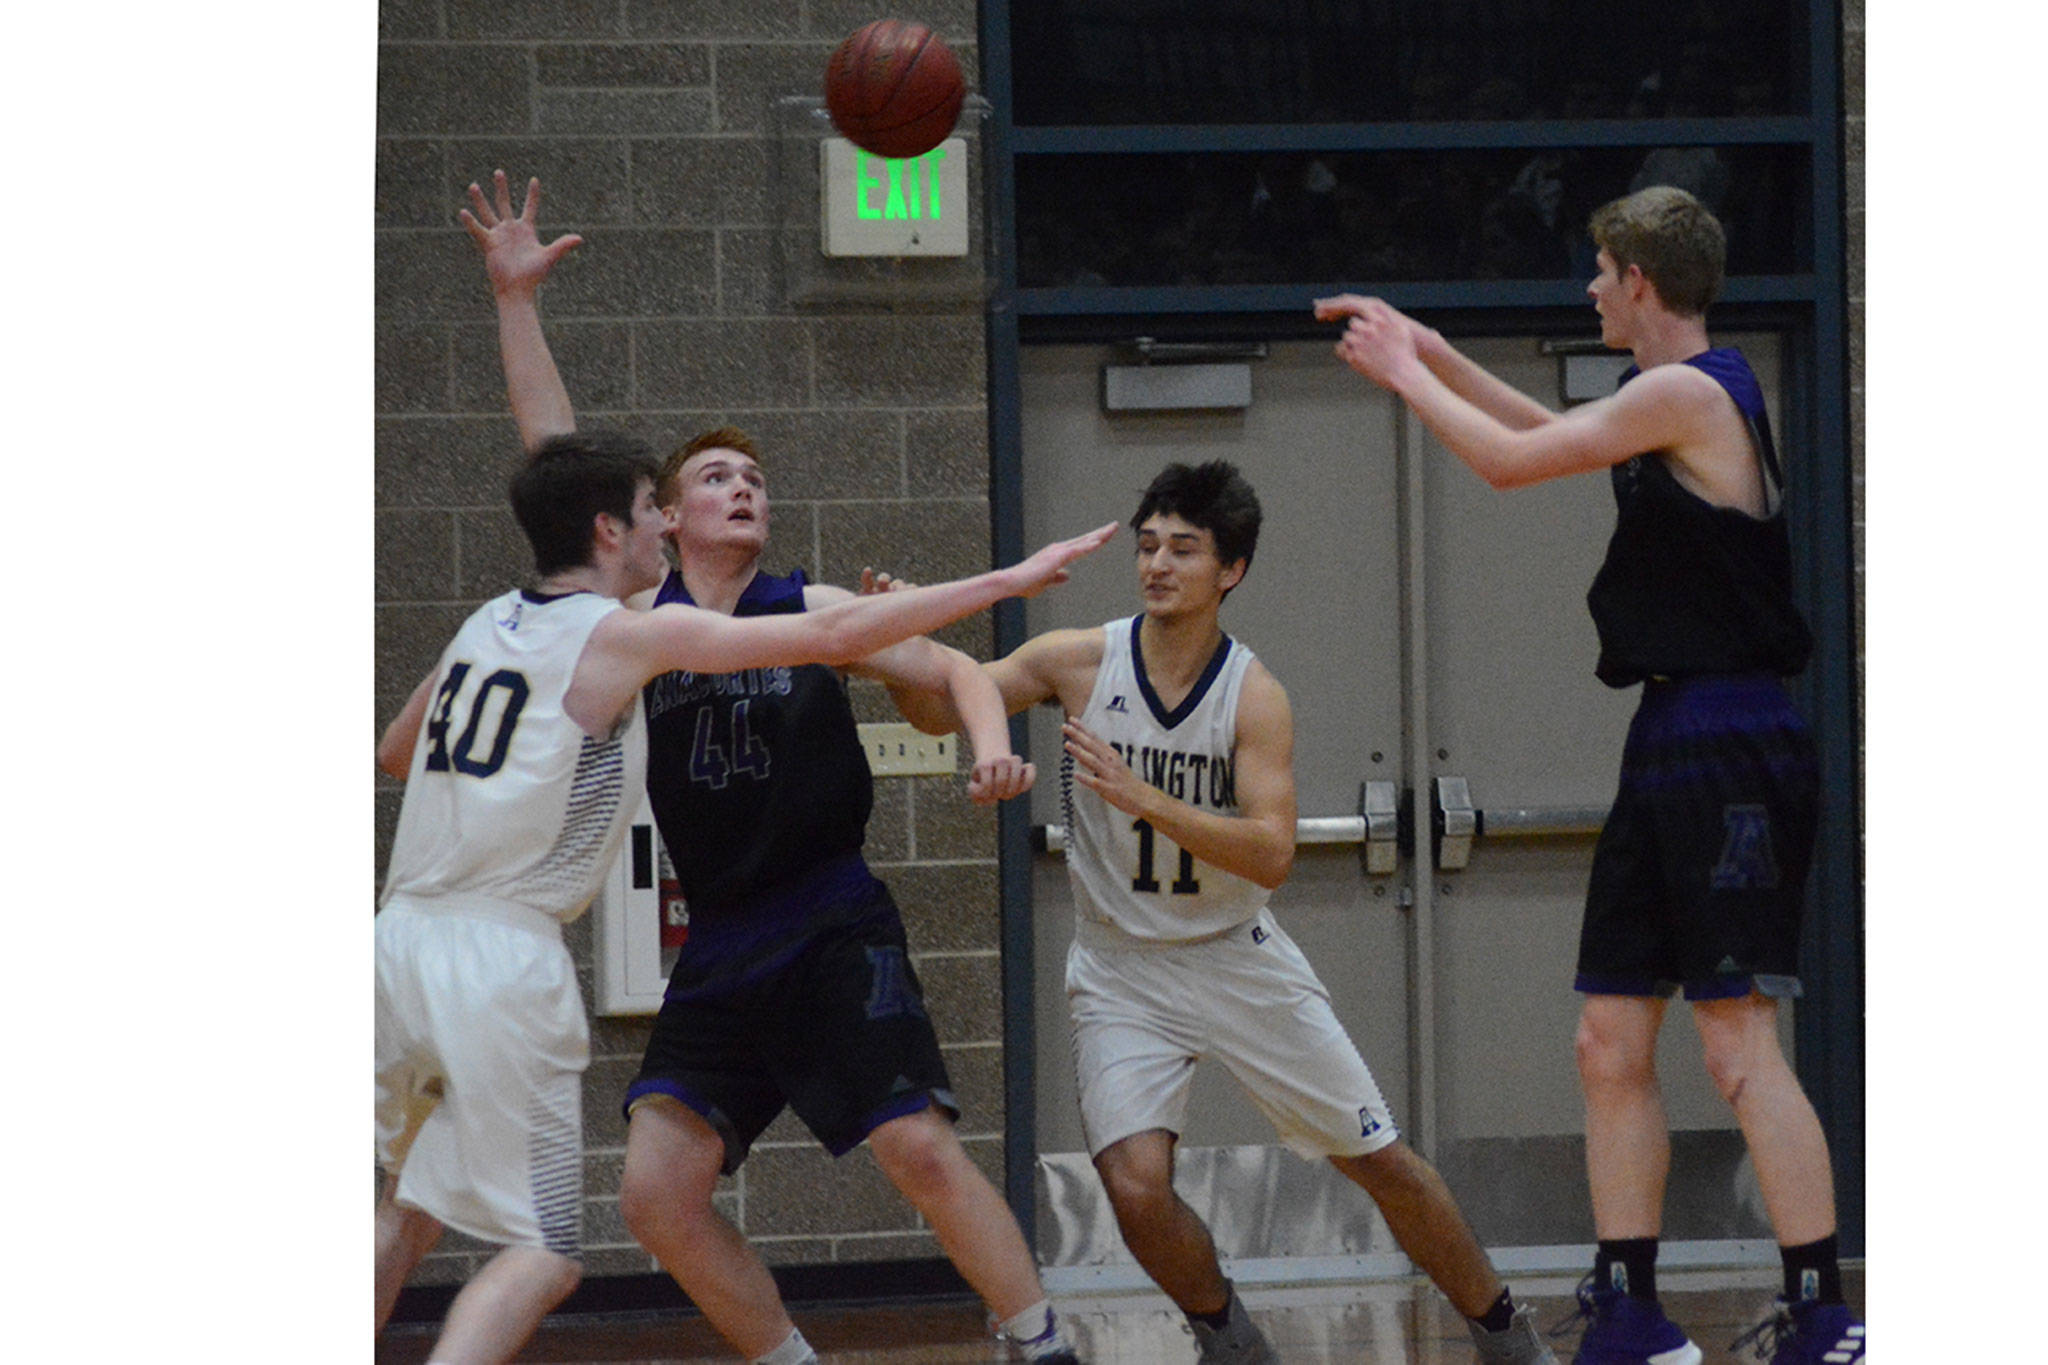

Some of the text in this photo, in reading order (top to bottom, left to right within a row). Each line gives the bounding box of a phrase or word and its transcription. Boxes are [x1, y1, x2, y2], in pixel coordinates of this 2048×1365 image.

[857, 148, 947, 220] EXIT
[425, 661, 529, 779] 40
[689, 699, 771, 790] 44
[1096, 741, 1238, 809] INGTON
[1132, 818, 1200, 894] 11
